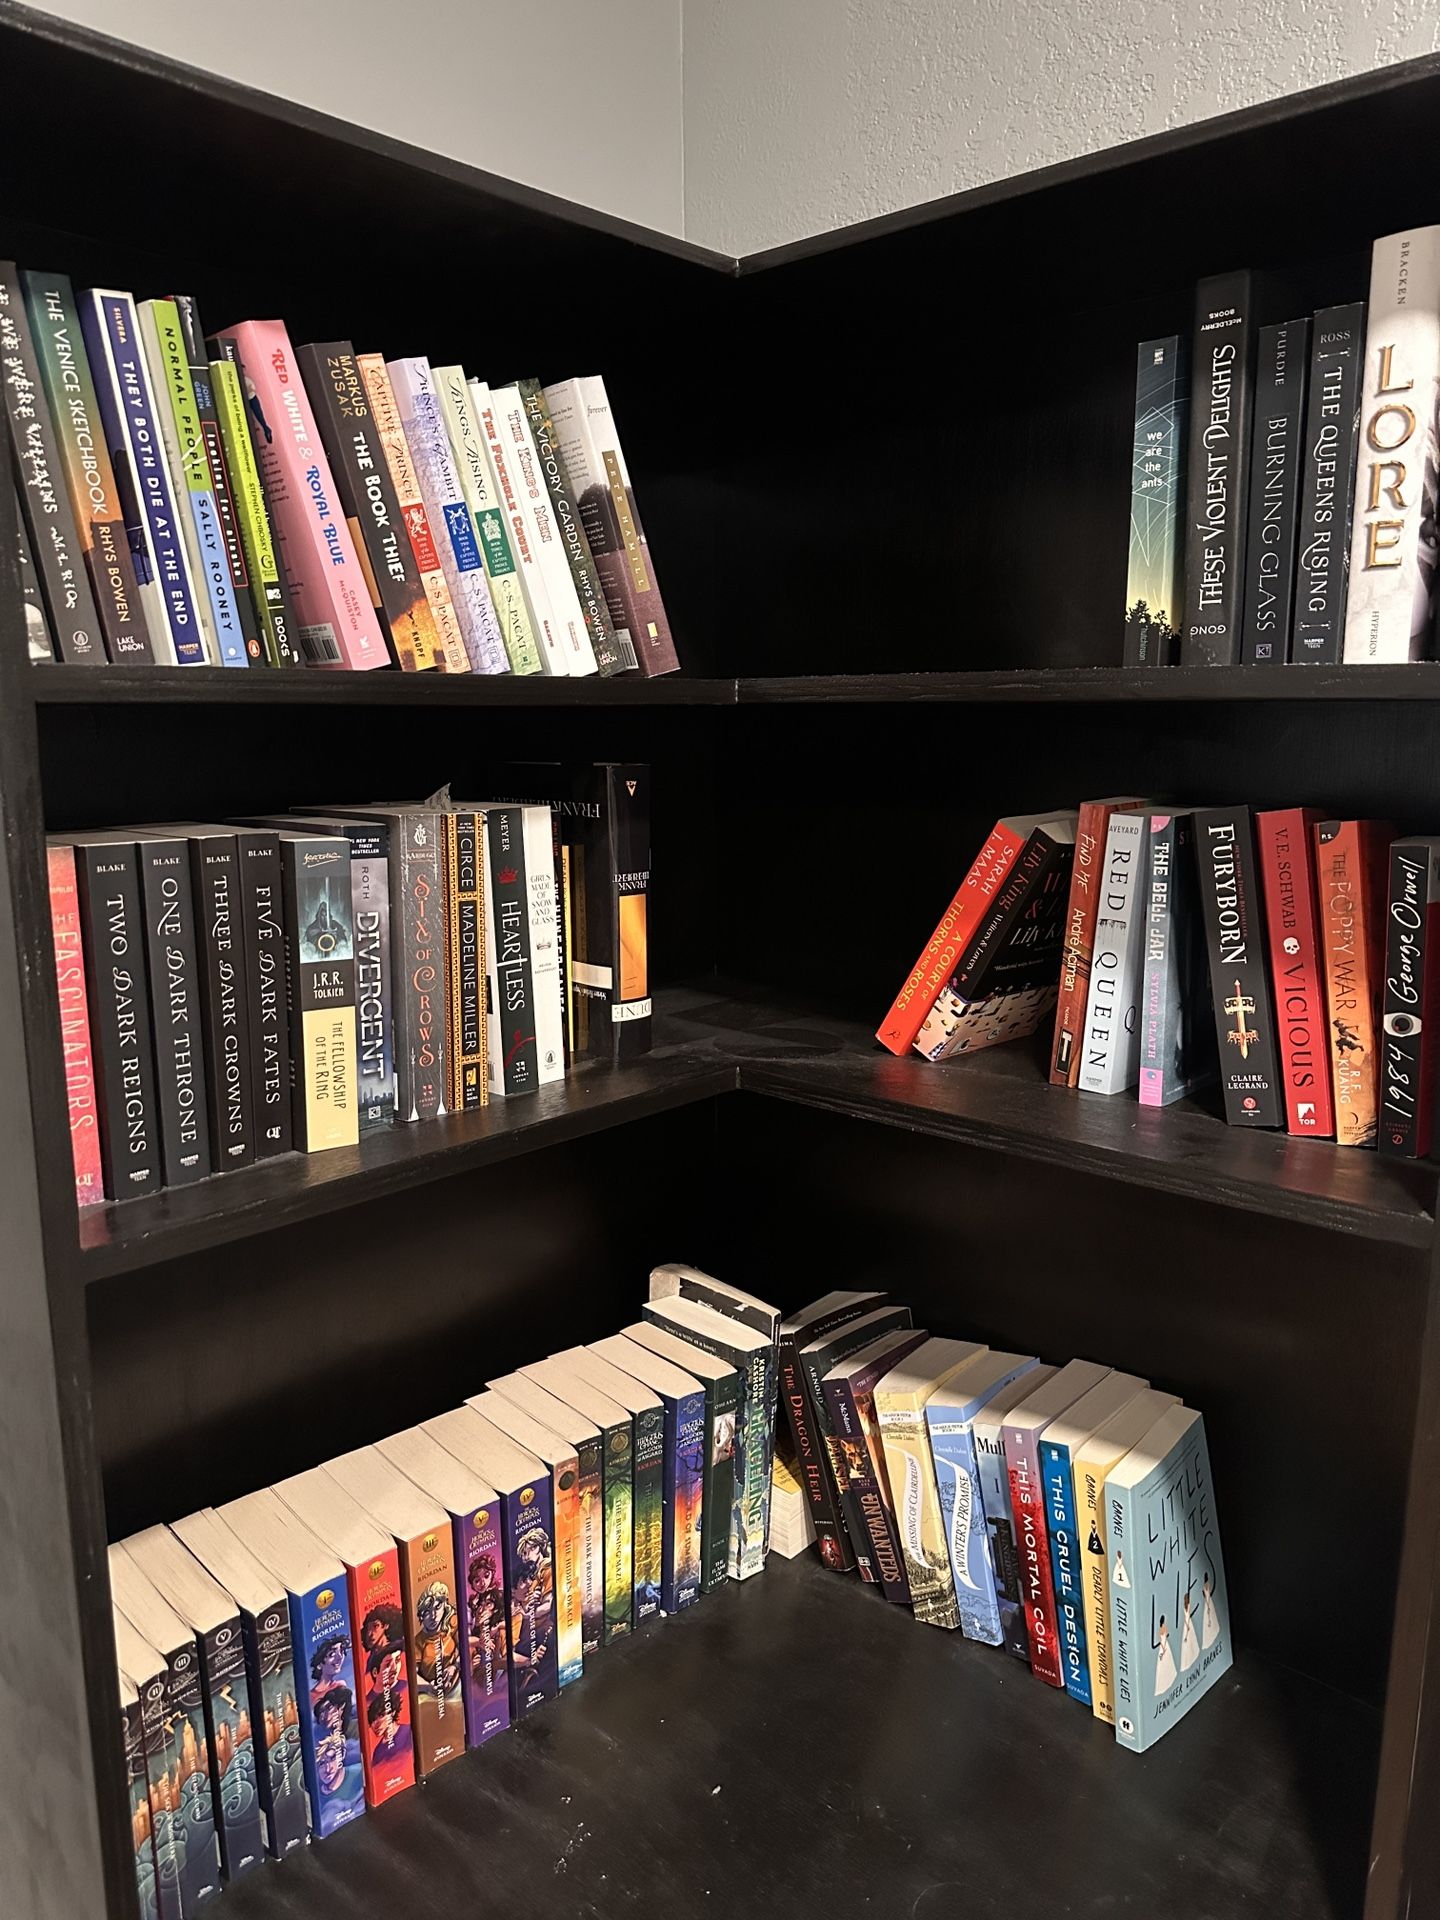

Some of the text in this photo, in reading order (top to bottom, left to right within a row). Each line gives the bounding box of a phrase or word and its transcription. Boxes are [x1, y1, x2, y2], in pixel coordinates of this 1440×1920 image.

[1397, 241, 1410, 304] BRACKEN
[112, 307, 127, 344] SILVERA
[1320, 330, 1351, 344] ROSS
[327, 358, 353, 419] ZUSAK
[339, 355, 368, 417] MARKUS
[1274, 330, 1287, 387] PURDIE
[45, 291, 108, 515] THE VENICE SKETCHBOOK
[165, 327, 203, 480] NORMAL PEOPLE
[586, 405, 609, 417] forever
[1145, 446, 1162, 456] are
[1145, 461, 1161, 472] the
[1146, 431, 1163, 441] we
[122, 361, 188, 625] THEY BOTH DIE AT THE END
[282, 390, 309, 443] WHITE
[298, 446, 313, 461] &
[306, 465, 330, 520] ROYAL
[323, 523, 345, 567] BLUE
[353, 432, 406, 582] THE BOOK THIEF
[481, 408, 533, 564] THE FOXHOLE COURT
[507, 410, 552, 544] THE KING'S MEN
[526, 394, 542, 421] THE
[537, 426, 565, 494] VICTORY
[558, 500, 584, 561] GARDEN
[1141, 477, 1163, 489] ants
[1197, 344, 1237, 611] THESE VIOLENT DELIGHTS
[1301, 366, 1343, 612] THE QUEEN'S RISING
[607, 458, 645, 586] PETE HAMILL
[1256, 417, 1288, 631] BURNING GLASS
[99, 526, 131, 622] RHYS BOWEN
[198, 499, 233, 631] SALLY ROONEY
[578, 569, 606, 641] RHYS BOWEN
[1190, 624, 1227, 637] GONG
[1369, 610, 1379, 656] HYPERION
[206, 855, 231, 864] BLAKE
[248, 849, 273, 857] BLAKE
[500, 814, 510, 852] MEYER
[1109, 825, 1139, 835] AVEYARD
[96, 863, 126, 873] BLAKE
[153, 857, 181, 866] BLAKE
[361, 866, 370, 899] ROTH
[460, 838, 474, 888] CIRCE
[530, 875, 551, 883] GIRLS
[980, 845, 1014, 895] SARAH
[531, 900, 552, 908] SNOW
[1147, 842, 1169, 961] THE BELL JAR
[1208, 823, 1247, 965] FURYBORN
[497, 901, 529, 1011] HEARTLESS
[1063, 908, 1087, 992] André Aciman
[1088, 848, 1131, 1069] RED QUEEN
[1329, 852, 1357, 1011] THE POPPY WAR
[1387, 856, 1426, 1004] George Orwell
[212, 875, 242, 1133] THREE DARK CROWNS
[256, 886, 282, 1104] FIVE DARK FATES
[313, 987, 344, 999] TOLKIEN
[356, 911, 385, 1080] DIVERGENT
[462, 905, 477, 1050] MADELINE MILLER
[106, 894, 147, 1153] TWO DARK REIGNS
[157, 877, 197, 1143] ONE DARK THRONE
[1147, 972, 1160, 1059] SYLVIA PLATH
[1283, 963, 1315, 1088] VICIOUS
[315, 1036, 330, 1100] OF THE RING
[331, 1021, 347, 1110] THE FELLOWSHIP
[1228, 1082, 1269, 1090] LEGRAND
[1231, 1074, 1263, 1083] CLAIRE
[1337, 1060, 1351, 1104] KUANG
[1384, 1043, 1416, 1119] 1984
[758, 1358, 766, 1398] KRISTIN
[809, 1365, 824, 1404] ARNOLD
[748, 1402, 766, 1526] GRACELING
[783, 1365, 822, 1502] THE DRAGON HEIR
[976, 1437, 1006, 1456] Mull
[1084, 1474, 1096, 1511] BARNES
[1112, 1500, 1123, 1539] BARNES
[1148, 1452, 1204, 1544] LITTLE
[469, 1541, 497, 1558] RIORDAN
[515, 1517, 542, 1535] RIORDAN
[585, 1534, 593, 1557] DARK
[1016, 1457, 1047, 1655] THIS MORTAL COIL
[364, 1593, 396, 1611] RIORDAN
[417, 1565, 447, 1583] RIORDAN
[565, 1558, 573, 1590] HIDDEN
[585, 1561, 594, 1605] PROPHECY
[1051, 1475, 1081, 1682] THIS CRUEL DESIGN
[312, 1620, 345, 1642] RIORDAN
[566, 1593, 574, 1629] ORACLE
[1034, 1664, 1056, 1678] SUVADA
[1116, 1597, 1131, 1703] LITTLE WHITE LIES
[1153, 1641, 1223, 1719] JENNIFER LYNN BARNES
[1066, 1682, 1089, 1698] SUVADA
